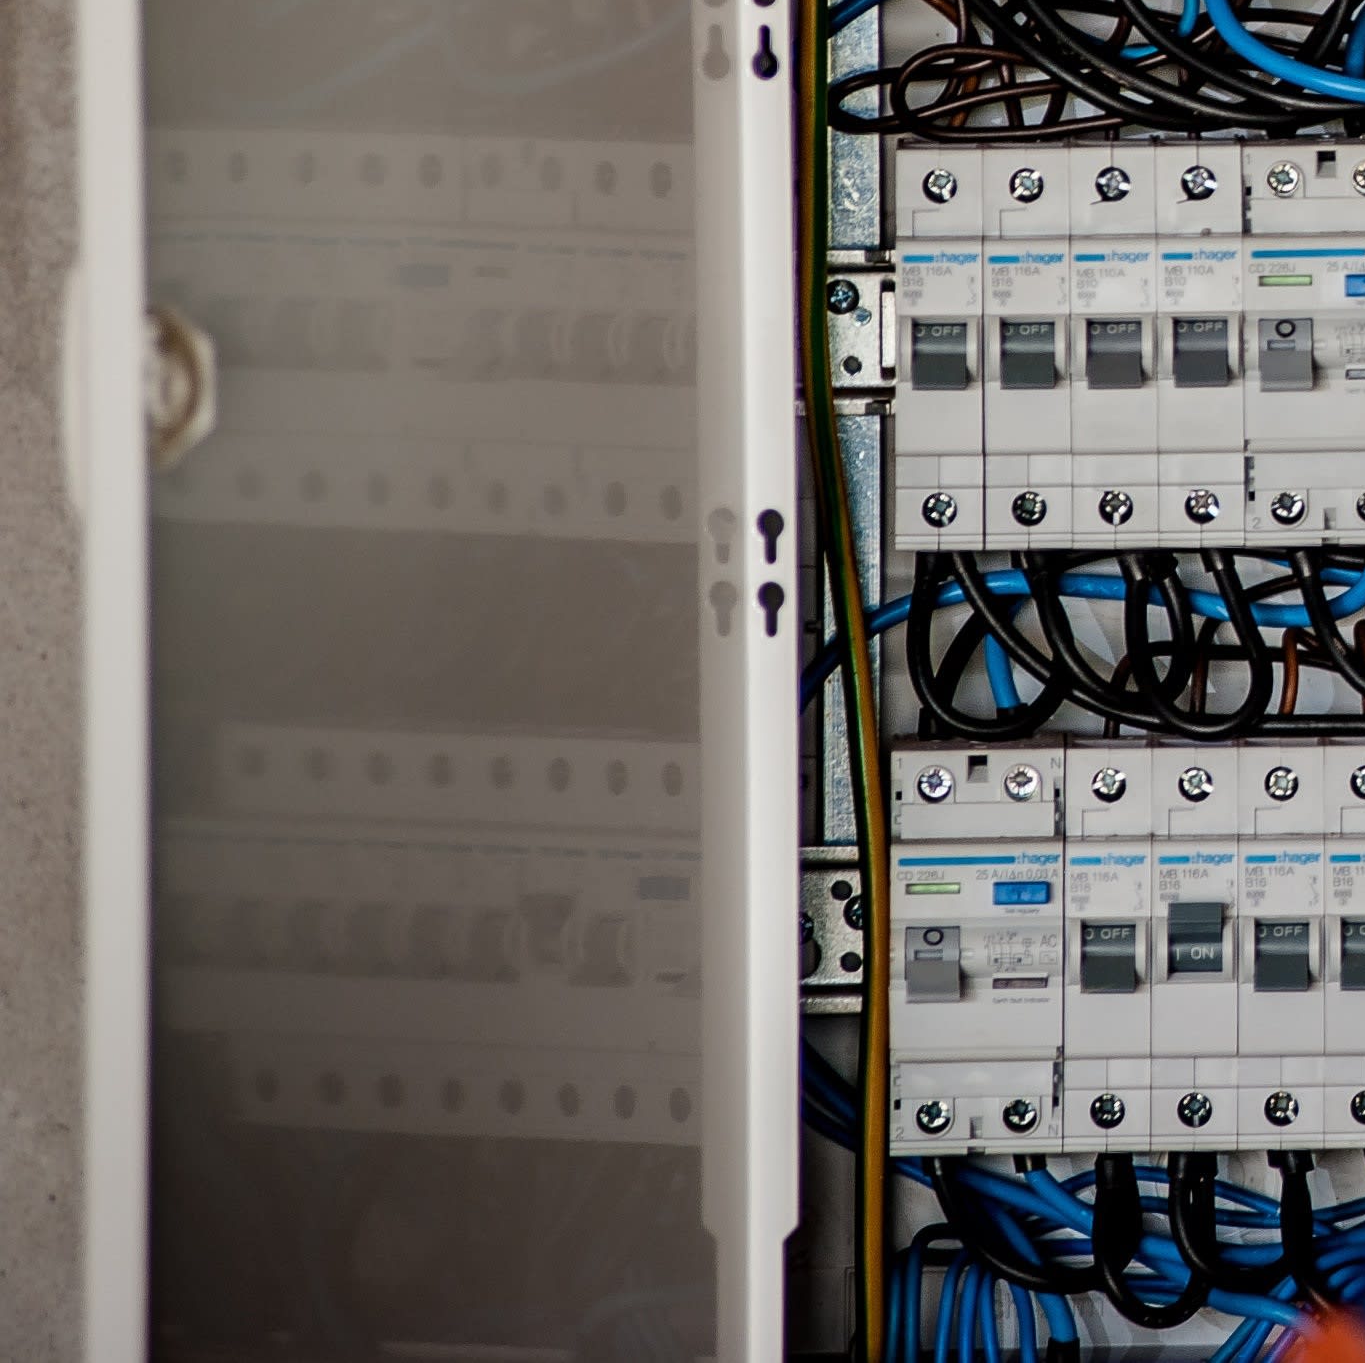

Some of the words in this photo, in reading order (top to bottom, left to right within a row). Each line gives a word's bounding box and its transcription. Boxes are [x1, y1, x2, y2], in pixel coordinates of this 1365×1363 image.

[942, 250, 980, 266] hager
[1025, 250, 1064, 266] hager
[1112, 246, 1150, 263] hager
[1199, 248, 1237, 262] hager
[926, 266, 953, 276] 116A
[1014, 266, 1041, 276] 116A
[1099, 269, 1126, 278] 110A
[1188, 265, 1215, 275] 110A
[931, 326, 962, 336] OFF
[1019, 325, 1050, 335] OFF
[1107, 324, 1137, 334] OFF
[1192, 322, 1223, 332] OFF
[1251, 517, 1261, 529] 2
[1050, 758, 1061, 769] N
[1022, 851, 1060, 866] hager
[1108, 852, 1146, 867] hager
[1196, 851, 1234, 866] hager
[1284, 850, 1321, 865] hager
[975, 869, 988, 880] 25
[1092, 872, 1118, 882] 116A
[1182, 868, 1209, 879] 116A
[1268, 866, 1295, 876] 116A
[1100, 928, 1130, 940] OFF
[1273, 925, 1303, 937] OFF
[1040, 933, 1057, 948] AC
[1190, 947, 1215, 960] ON
[1048, 1124, 1059, 1136] N
